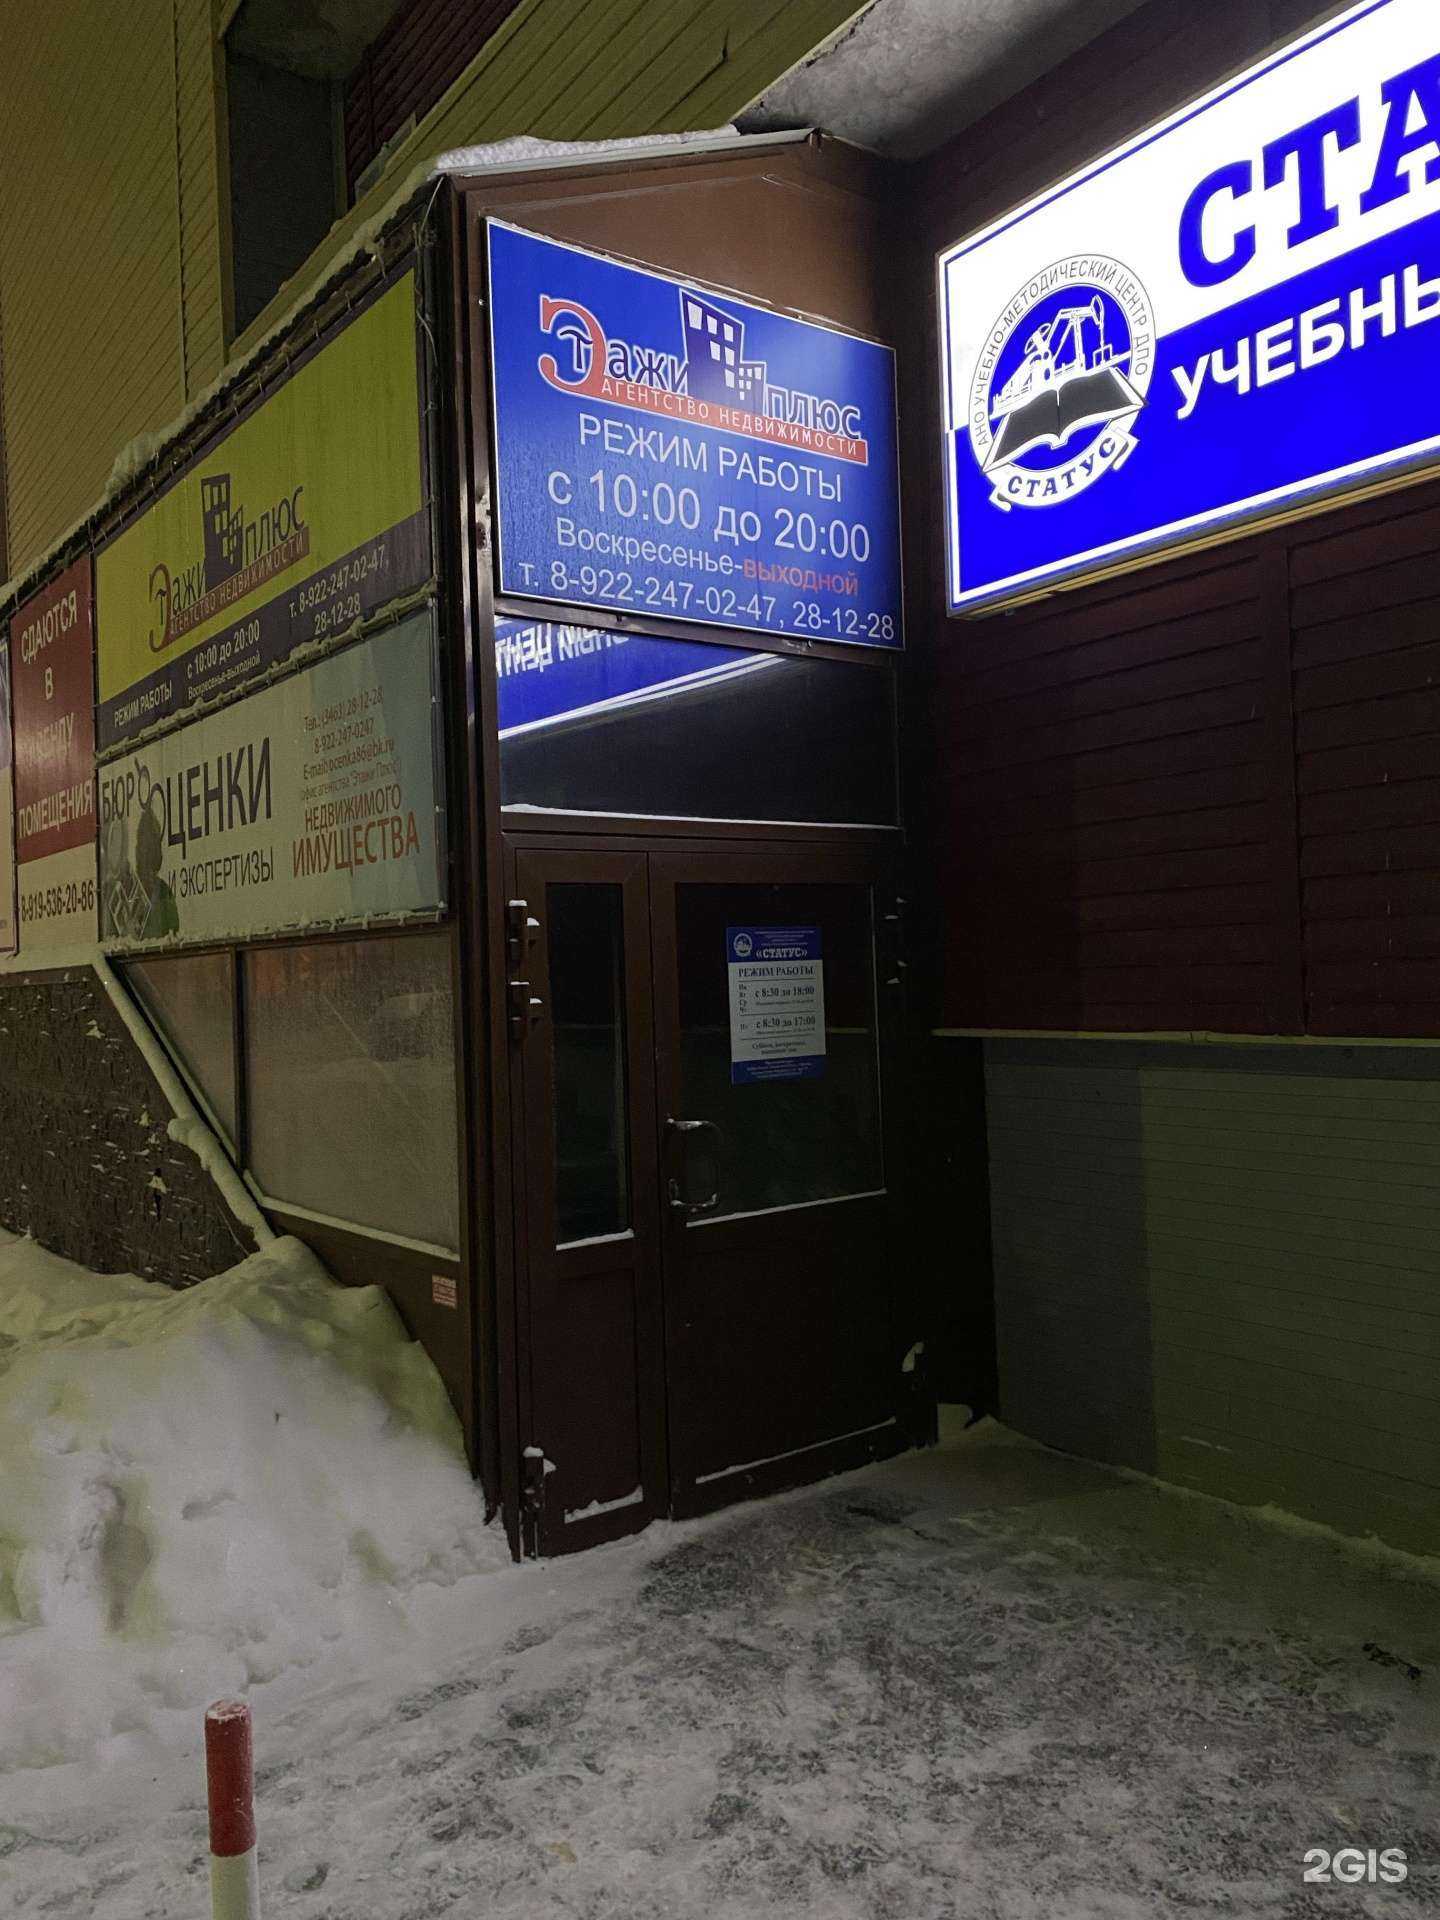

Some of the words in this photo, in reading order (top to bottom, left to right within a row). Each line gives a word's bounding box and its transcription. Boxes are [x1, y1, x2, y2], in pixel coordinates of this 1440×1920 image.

[974, 259, 1118, 402] УЧЕБНО-МЕТОДИЧЕСКИЙ
[1114, 277, 1148, 329] ЦЕНТР
[1134, 332, 1150, 376] ДПО
[600, 378, 709, 419] АГЕНТСТВО
[719, 407, 857, 457] НЕДВИЖИМОСТИ
[579, 412, 708, 472] РЕЖИМ
[719, 446, 842, 502] РАБОТЫ
[1007, 437, 1116, 498] СТАТУС
[588, 469, 701, 530] 10:00
[774, 508, 870, 562] 20:00
[21, 589, 78, 664] СДАЮТСЯ
[314, 592, 360, 635] 28-12-28
[550, 560, 785, 629] 8-922-247-02-47,
[793, 601, 894, 640] 28-12-28
[195, 644, 217, 674] 10:00
[233, 618, 260, 652] 20:00
[113, 698, 140, 728] РЕЖИМ
[140, 680, 173, 714] РАБОТЫ
[18, 778, 94, 839] ПОМЕЩЕНИЯ
[305, 784, 402, 834] НЕДВИЖИМОГО
[179, 846, 274, 898] ЭКСПЕРТИЗЫ
[293, 811, 420, 878] ИМУЩЕСТВА
[20, 880, 94, 922] 8-919-536-20-86
[738, 966, 774, 977] РЕЖИМ
[776, 965, 815, 976] РАБОТЫ
